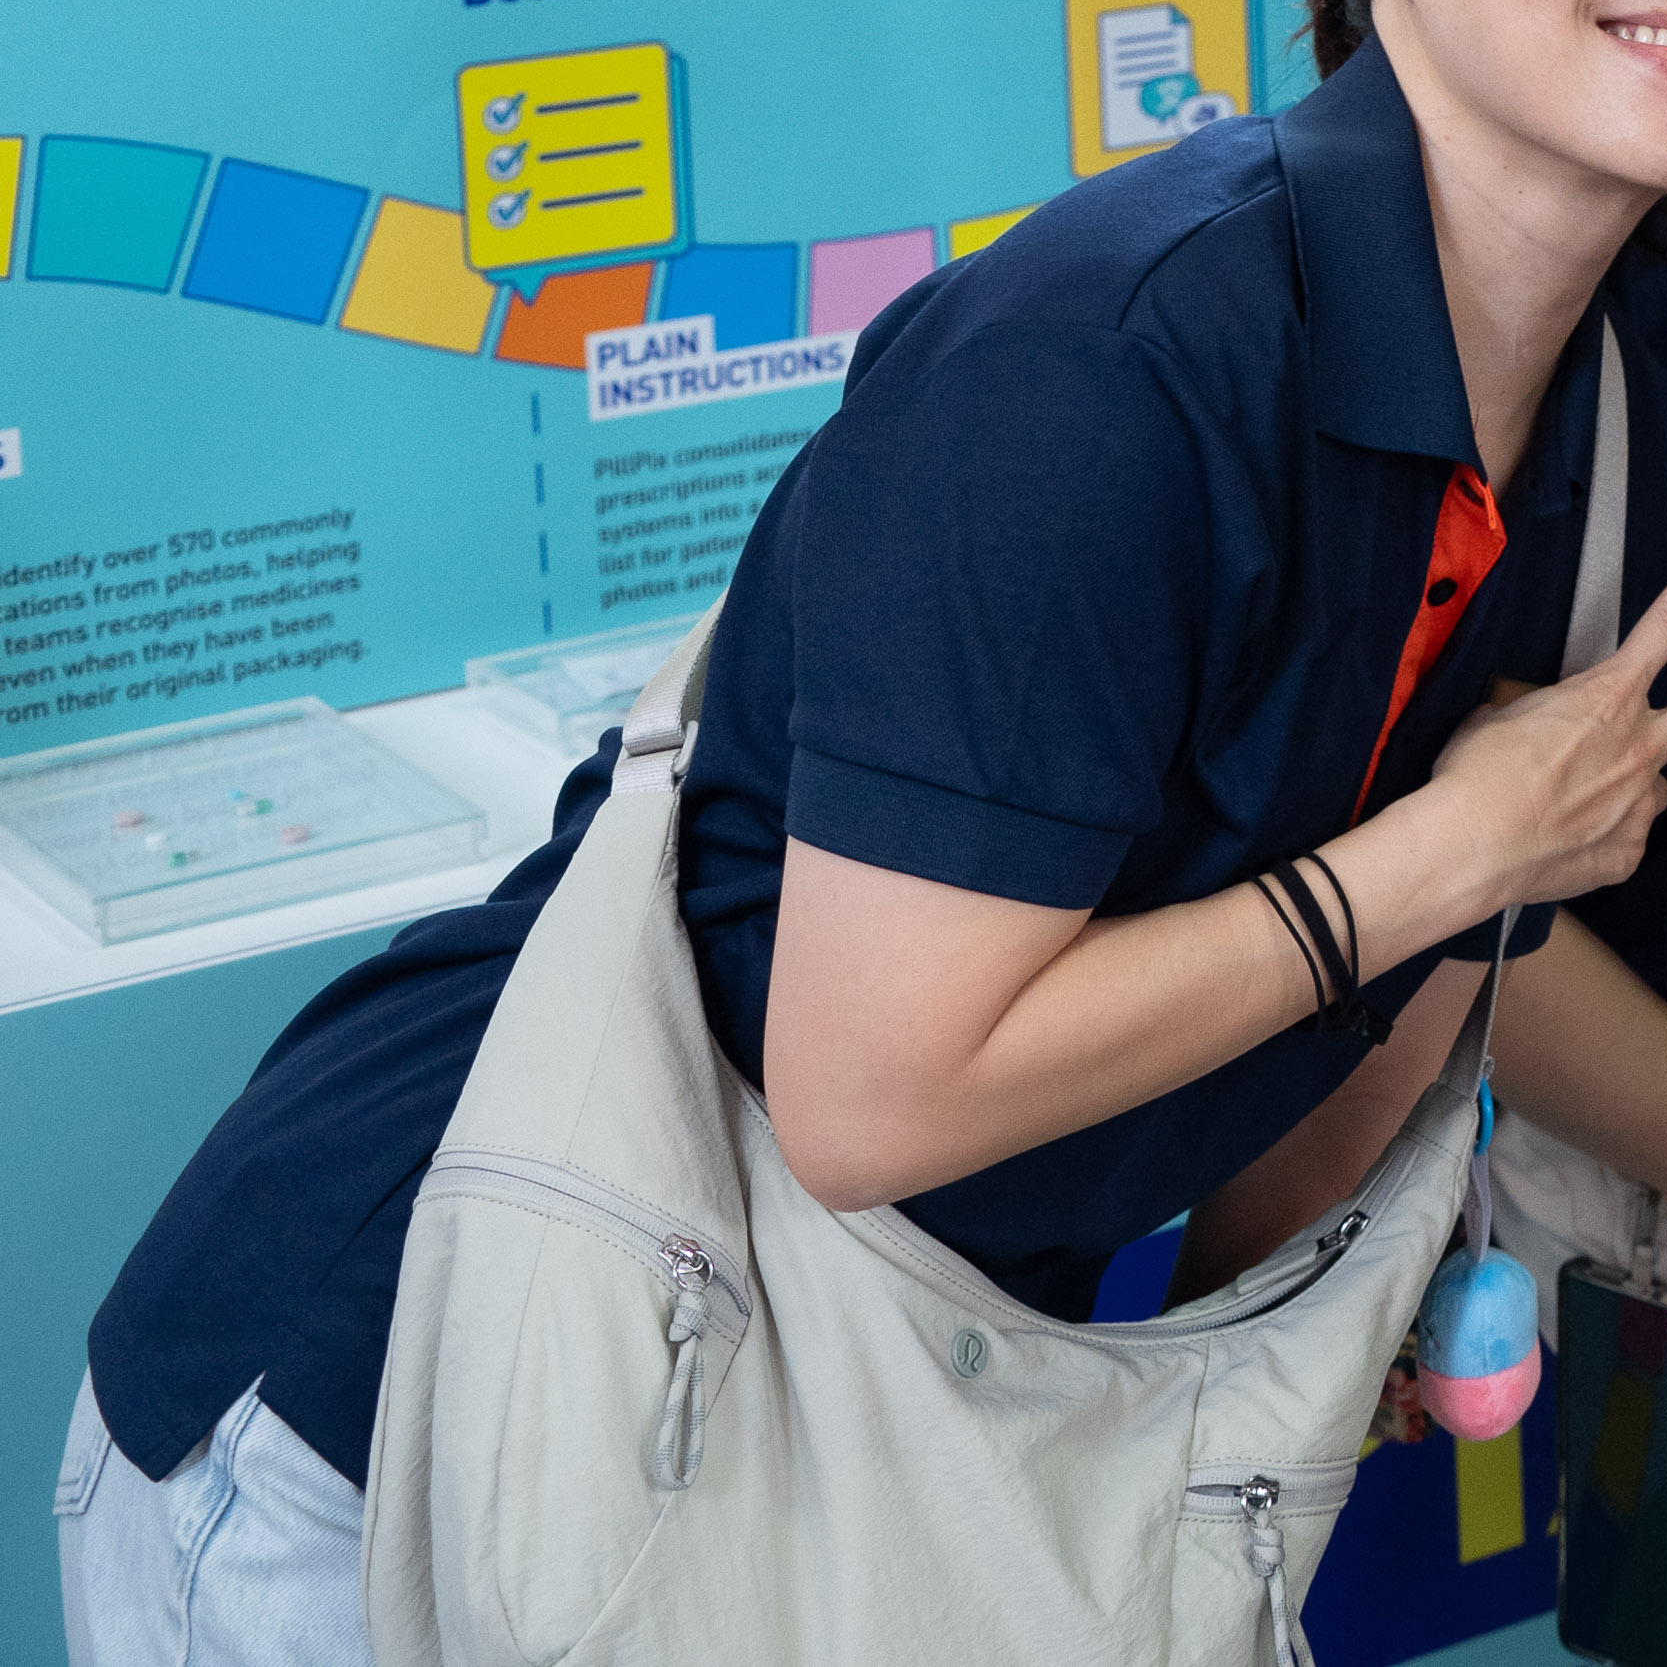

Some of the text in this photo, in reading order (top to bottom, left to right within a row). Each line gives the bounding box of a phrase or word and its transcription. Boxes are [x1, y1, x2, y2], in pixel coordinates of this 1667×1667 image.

[597, 328, 699, 371] PLAIN
[600, 341, 846, 410] INSTRUCTIONS
[0, 504, 356, 589] dentify over 570 commonly
[0, 539, 363, 625] ations from photos, helping
[3, 571, 363, 658] teams recognise medicines
[62, 650, 137, 679] when
[142, 638, 199, 665] they
[203, 623, 267, 653] have
[270, 609, 337, 638] been
[56, 684, 121, 716] their
[126, 660, 227, 700] original
[232, 637, 372, 685] packaging.
